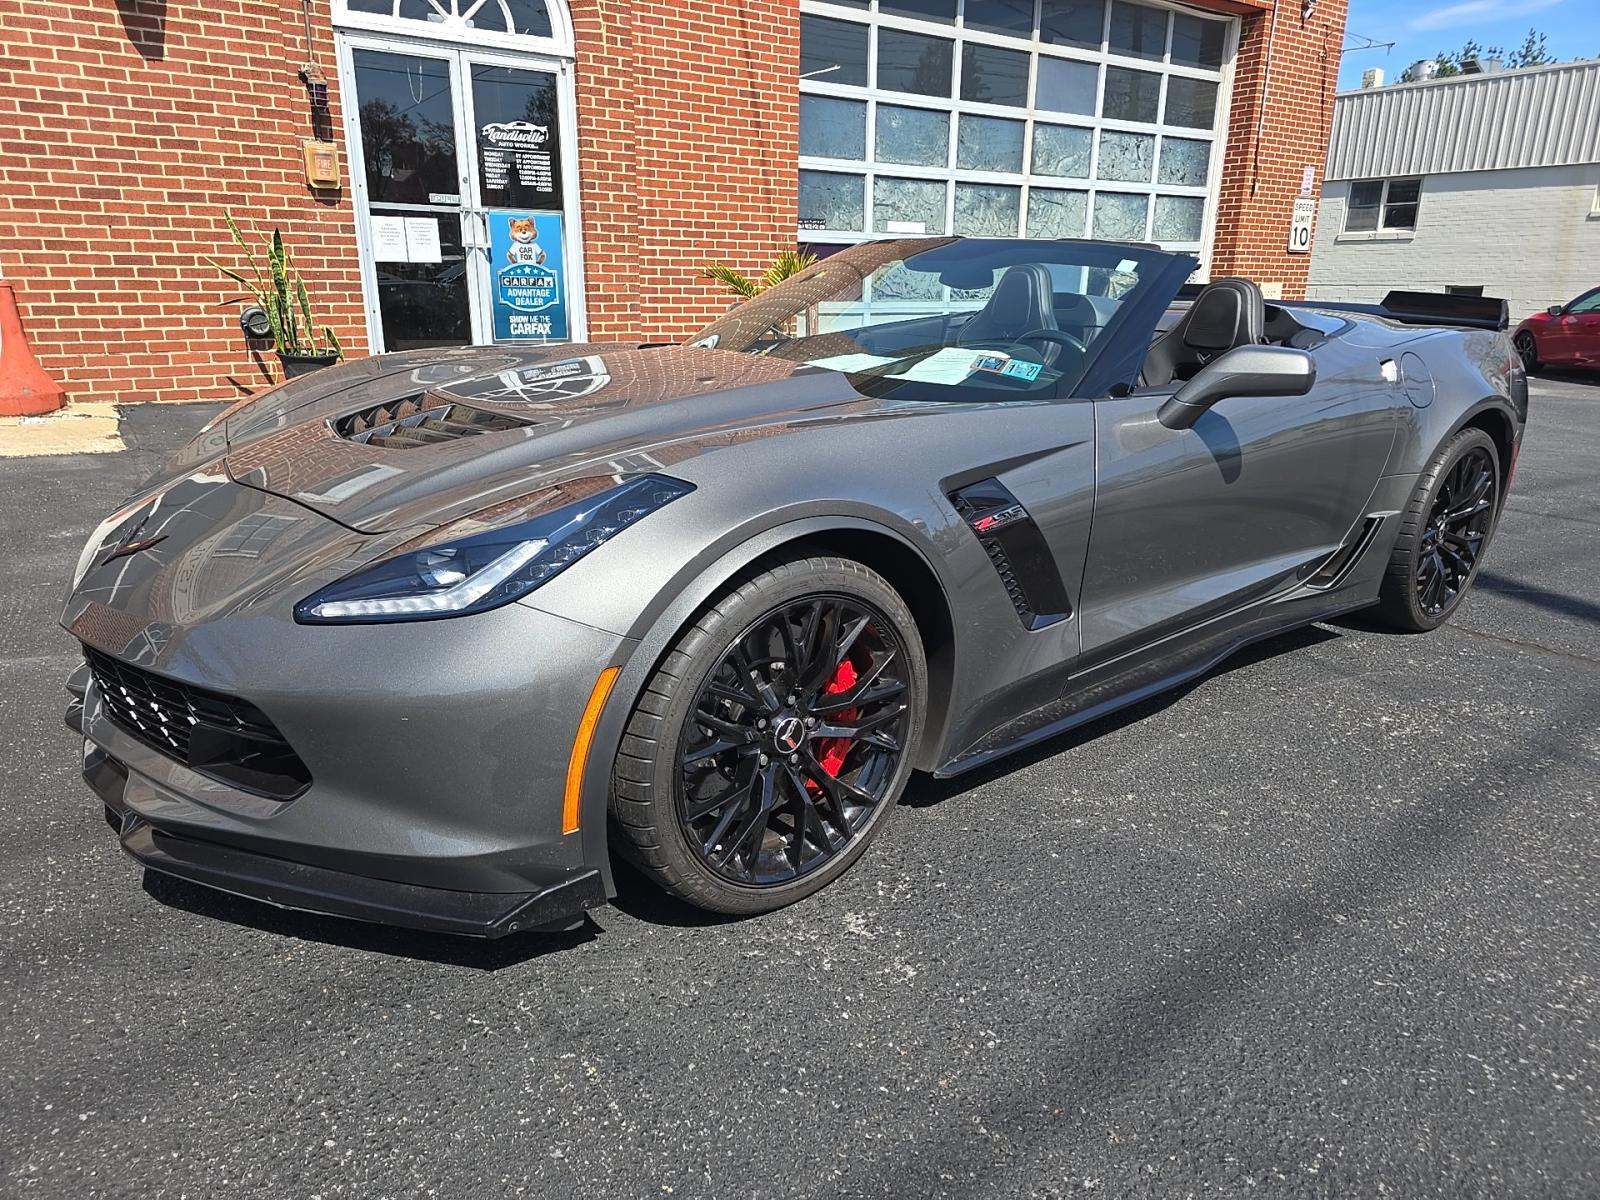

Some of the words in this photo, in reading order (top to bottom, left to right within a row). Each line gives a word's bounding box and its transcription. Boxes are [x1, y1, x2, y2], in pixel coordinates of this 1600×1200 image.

[488, 128, 545, 143] Landisville
[1295, 203, 1313, 212] SPEED
[1295, 215, 1310, 223] LIMIT
[1293, 226, 1309, 246] 10
[519, 246, 533, 254] CAR
[503, 277, 553, 287] CARFAX
[507, 288, 551, 297] ADVANTAGE
[515, 297, 544, 306] DEALER
[509, 315, 529, 323] SHOW
[539, 315, 551, 323] THE
[510, 323, 552, 335] CARFAX
